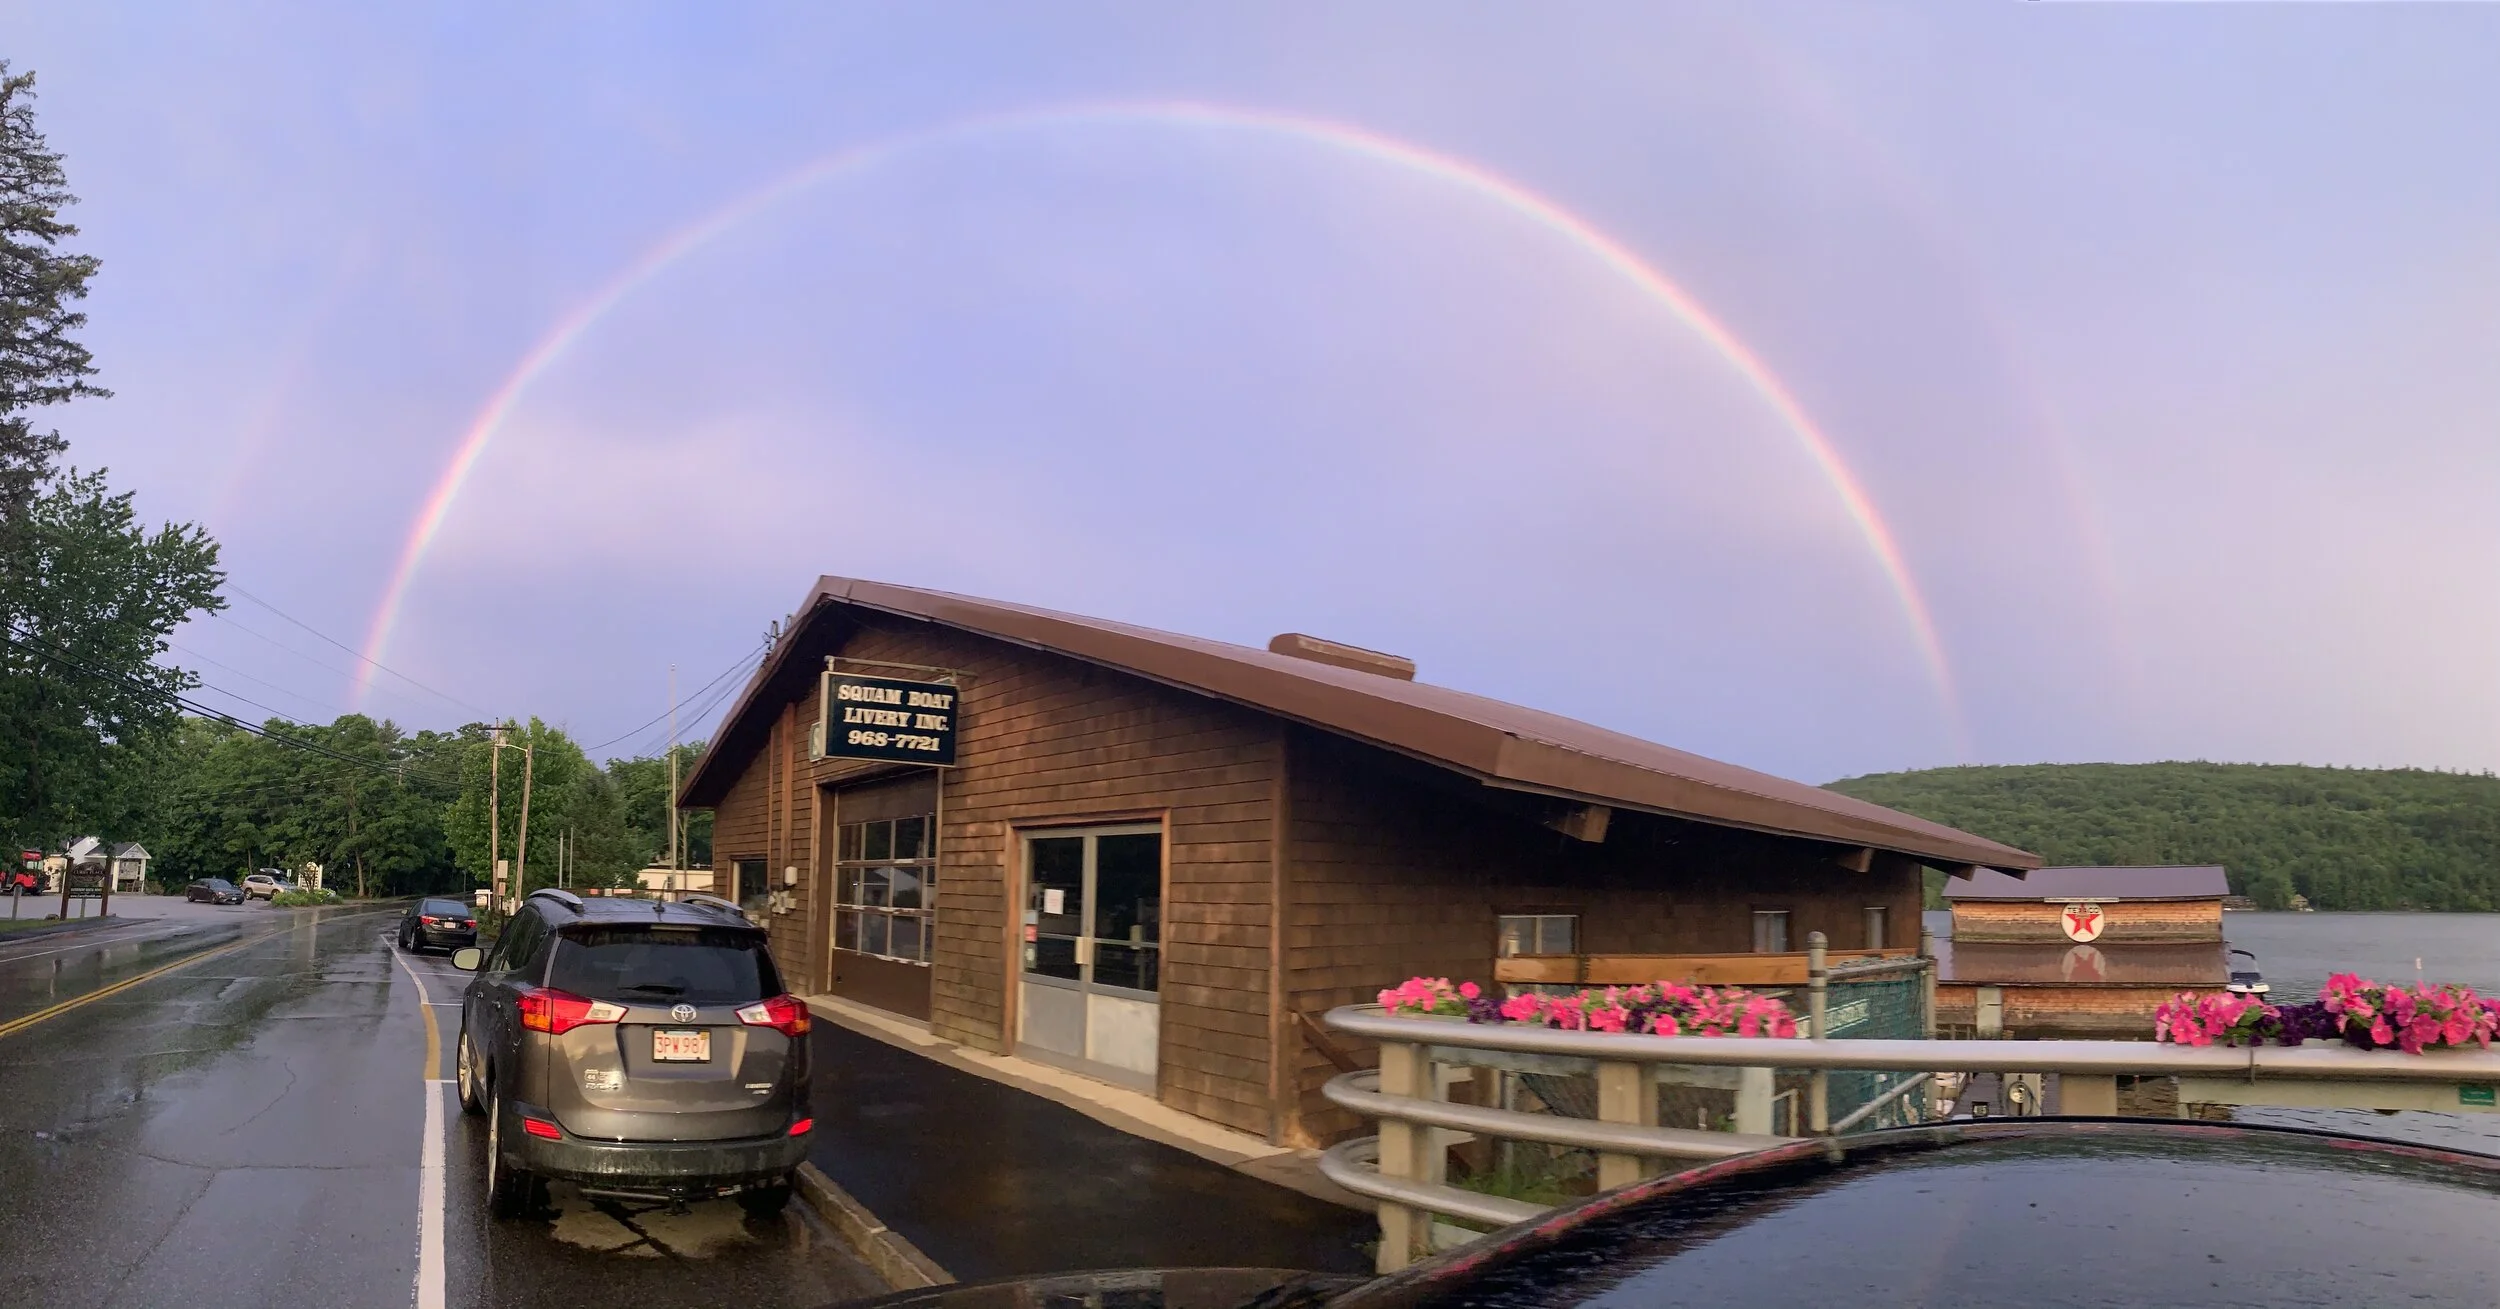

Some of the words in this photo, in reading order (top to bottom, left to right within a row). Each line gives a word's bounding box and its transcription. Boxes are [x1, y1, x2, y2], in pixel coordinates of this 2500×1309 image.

[837, 684, 903, 705] SQUAM
[907, 691, 953, 709] BOAT
[843, 707, 911, 727] LIVERY
[914, 713, 949, 731] INC.
[847, 730, 940, 751] 968-7721
[656, 1036, 679, 1053] 3PW
[682, 1037, 706, 1054] 987
